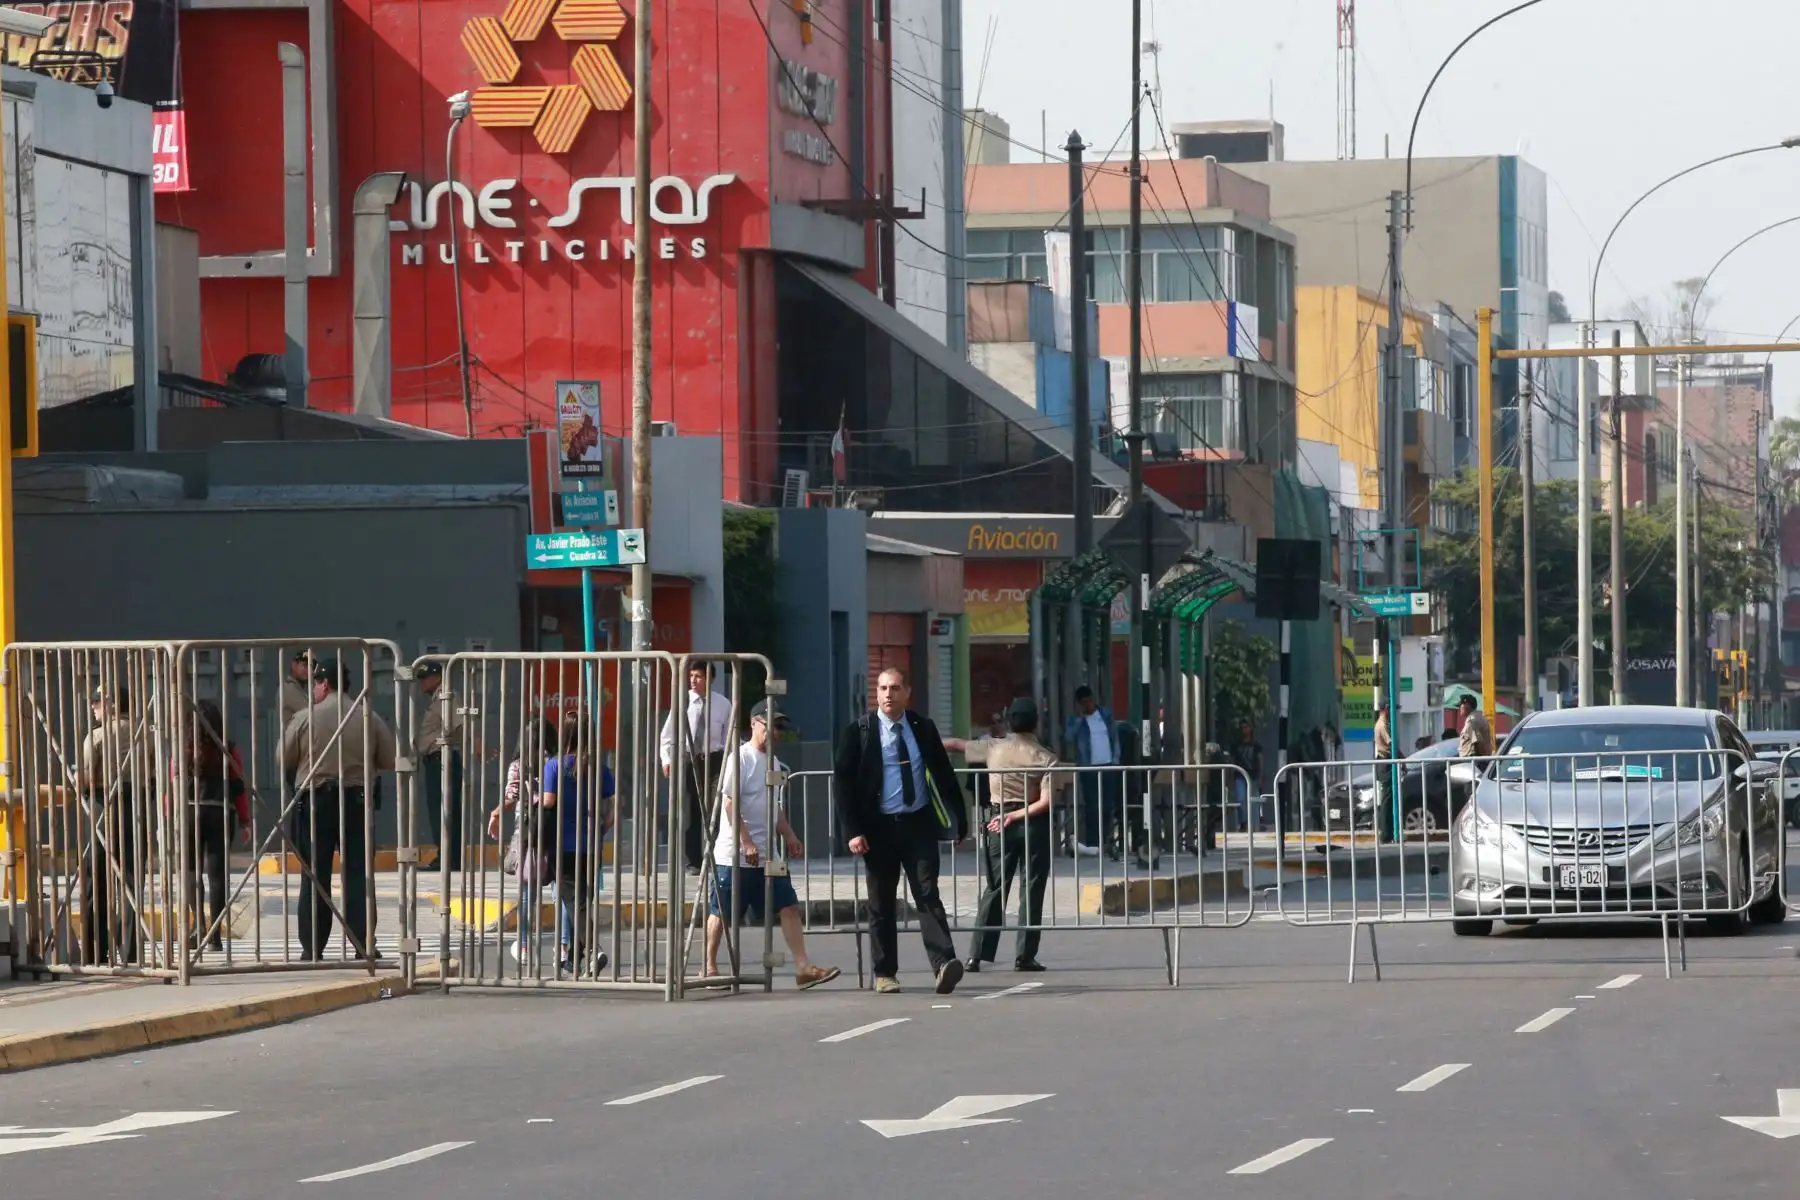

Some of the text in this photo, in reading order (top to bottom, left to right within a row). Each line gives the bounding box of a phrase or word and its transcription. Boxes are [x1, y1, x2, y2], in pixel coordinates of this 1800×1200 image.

[402, 237, 707, 265] MULTICINES
[547, 536, 569, 549] Javier
[569, 535, 590, 548] Prado
[591, 534, 607, 547] Este
[968, 524, 1058, 551] Aviación
[569, 551, 596, 561] Cuadra
